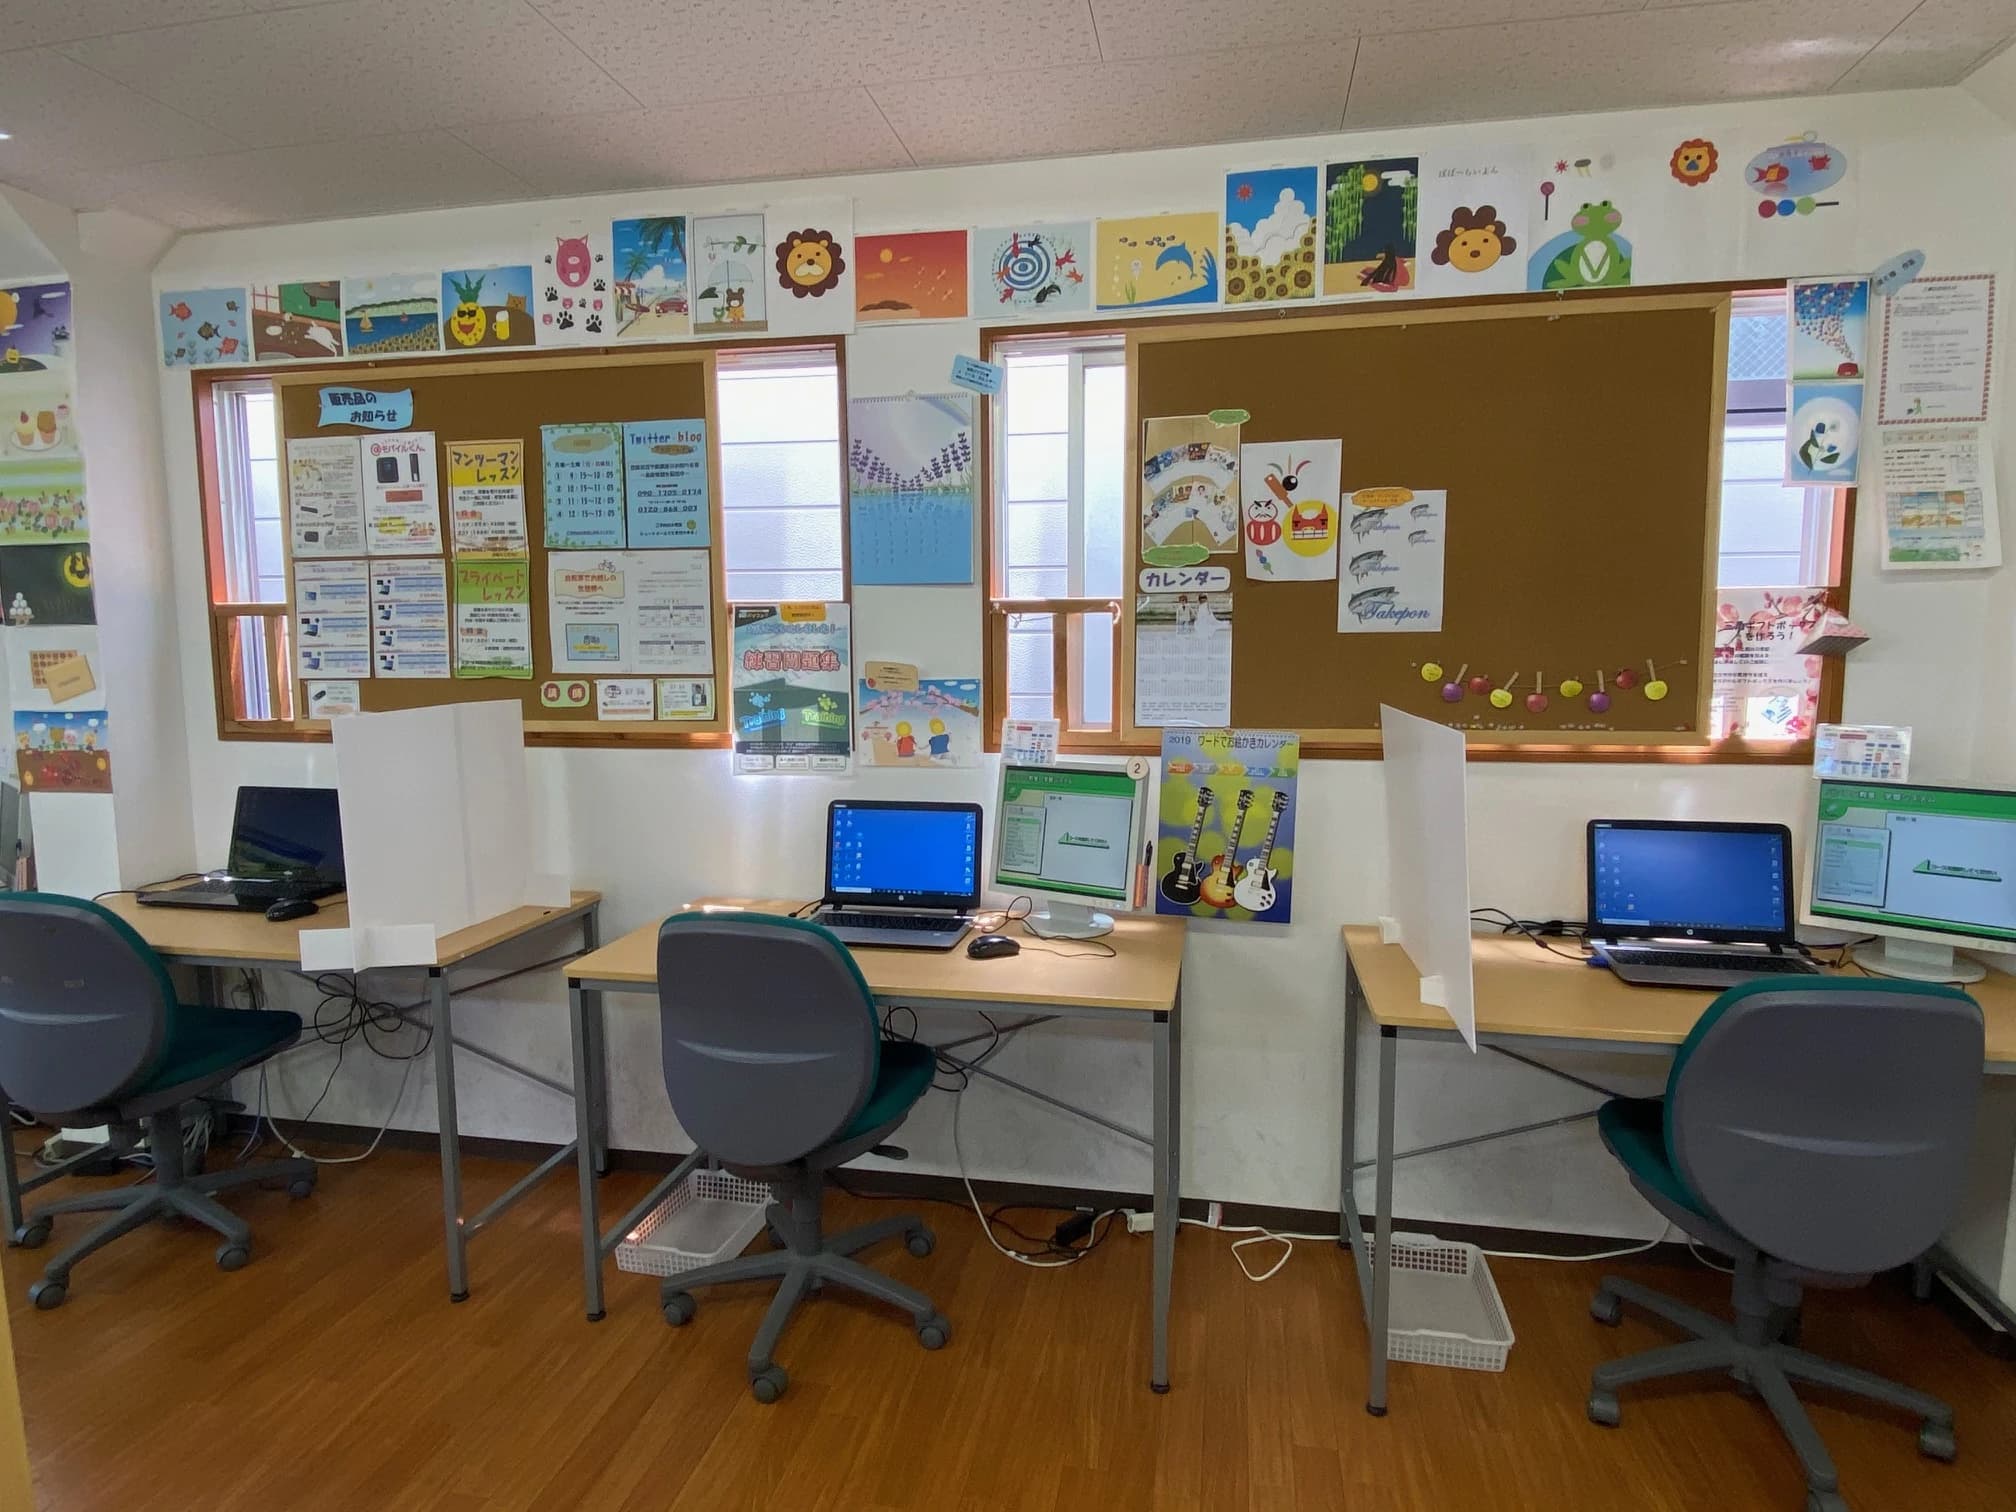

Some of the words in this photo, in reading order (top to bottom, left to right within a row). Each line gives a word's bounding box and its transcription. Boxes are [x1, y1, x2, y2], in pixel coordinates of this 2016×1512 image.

[328, 392, 377, 406] 販売品の
[350, 409, 398, 423] お知らせ
[630, 432, 670, 445] Twitter
[453, 449, 519, 466] マンツーマン
[476, 469, 520, 484] レッスン
[459, 568, 524, 586] プライベート
[1146, 571, 1225, 588] カレンダー
[481, 585, 525, 601] レッスン
[1363, 600, 1431, 626] Takepon
[743, 650, 841, 672] 練習問題集
[1168, 735, 1192, 745] 2019
[1132, 762, 1142, 774] 2
